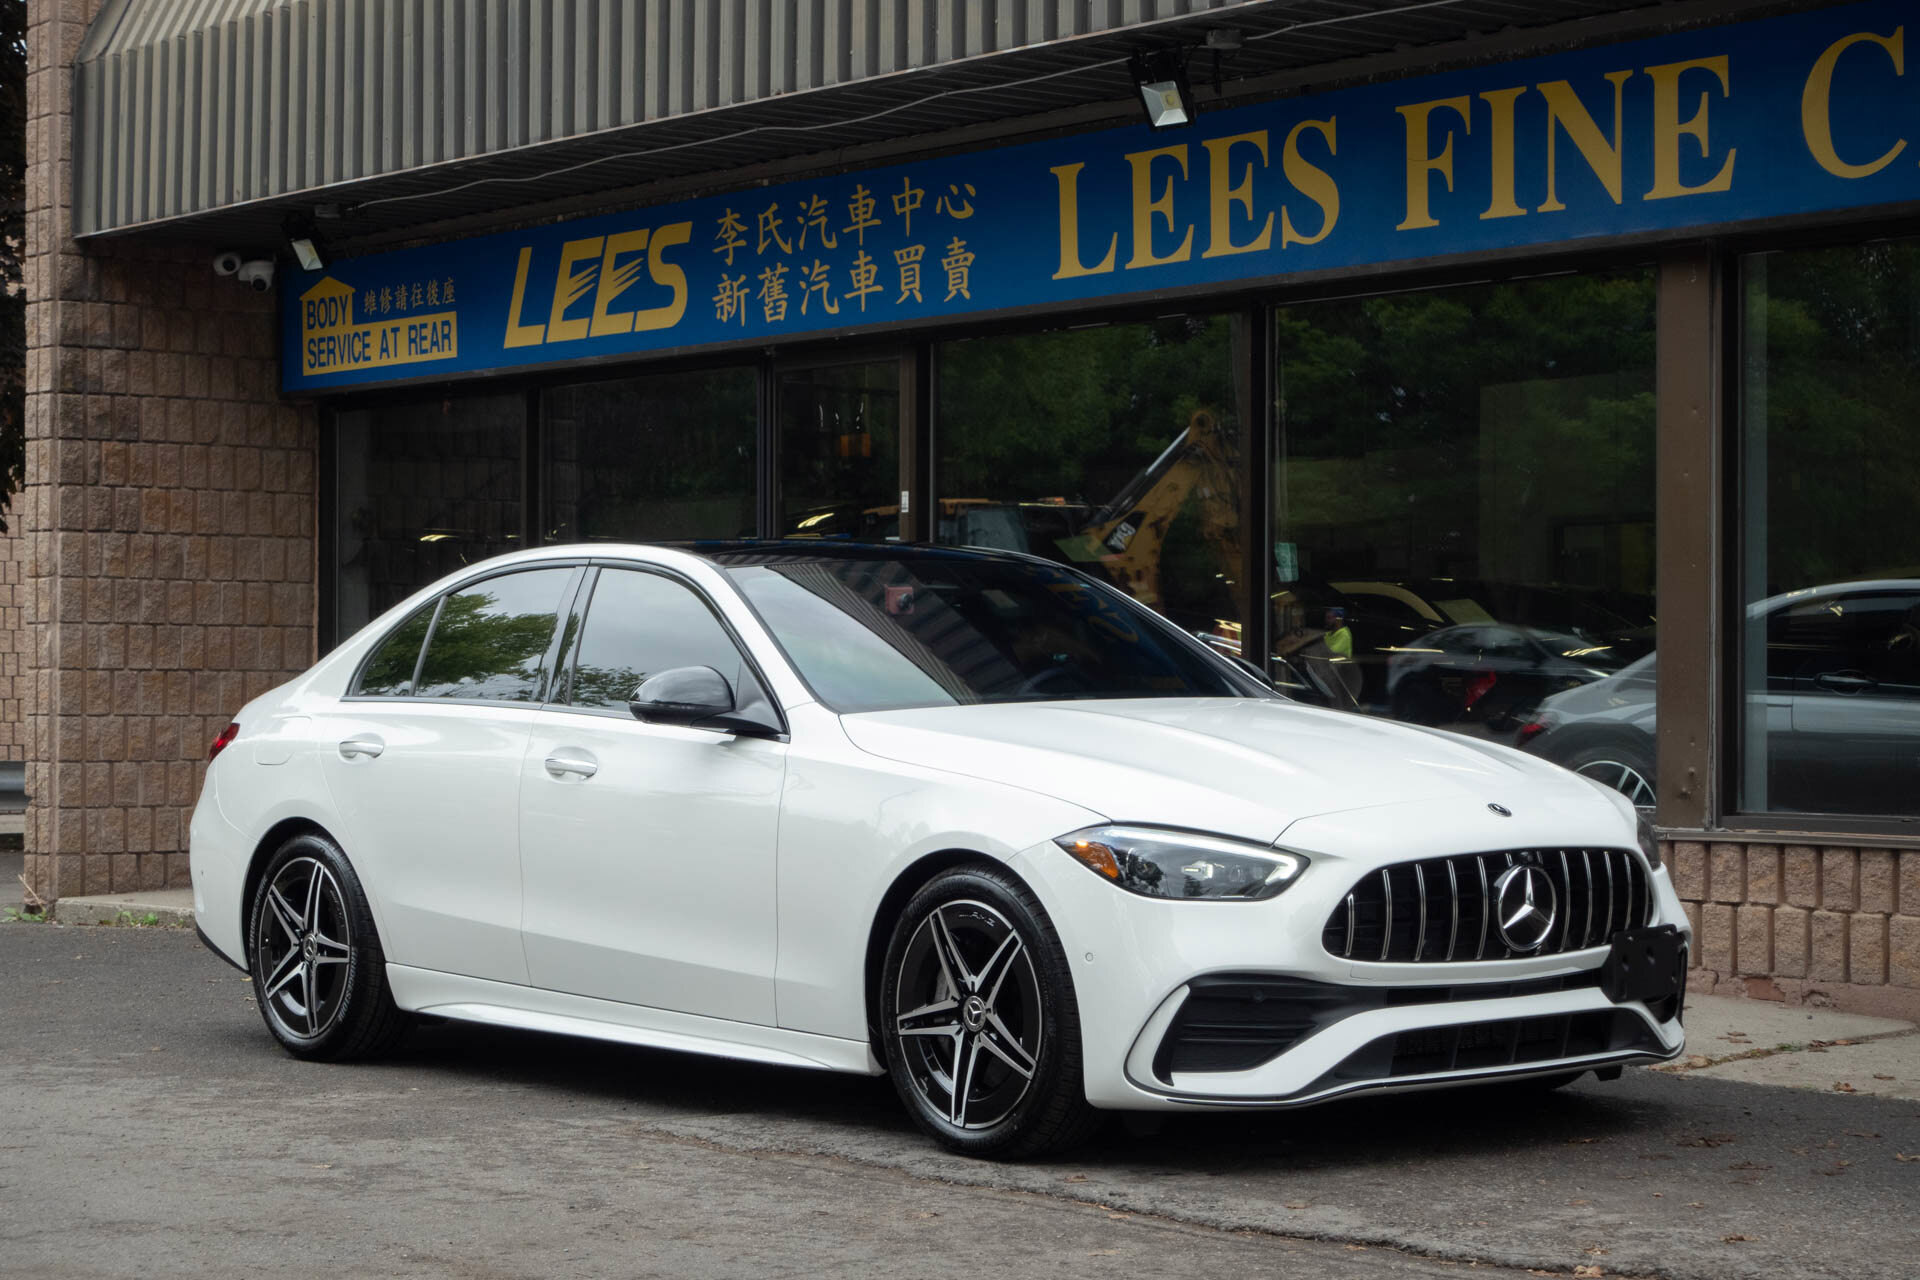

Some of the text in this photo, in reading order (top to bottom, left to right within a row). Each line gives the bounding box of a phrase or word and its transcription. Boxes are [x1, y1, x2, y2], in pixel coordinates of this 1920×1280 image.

[1050, 116, 1340, 280] LEES
[1396, 54, 1737, 231] FINE
[713, 177, 976, 266] 李氏汽車中心
[306, 294, 349, 330] BODY
[504, 221, 692, 349] LEES
[712, 237, 976, 326] 新舊汽車買賣
[307, 320, 452, 369] SERVICE AT REAR
